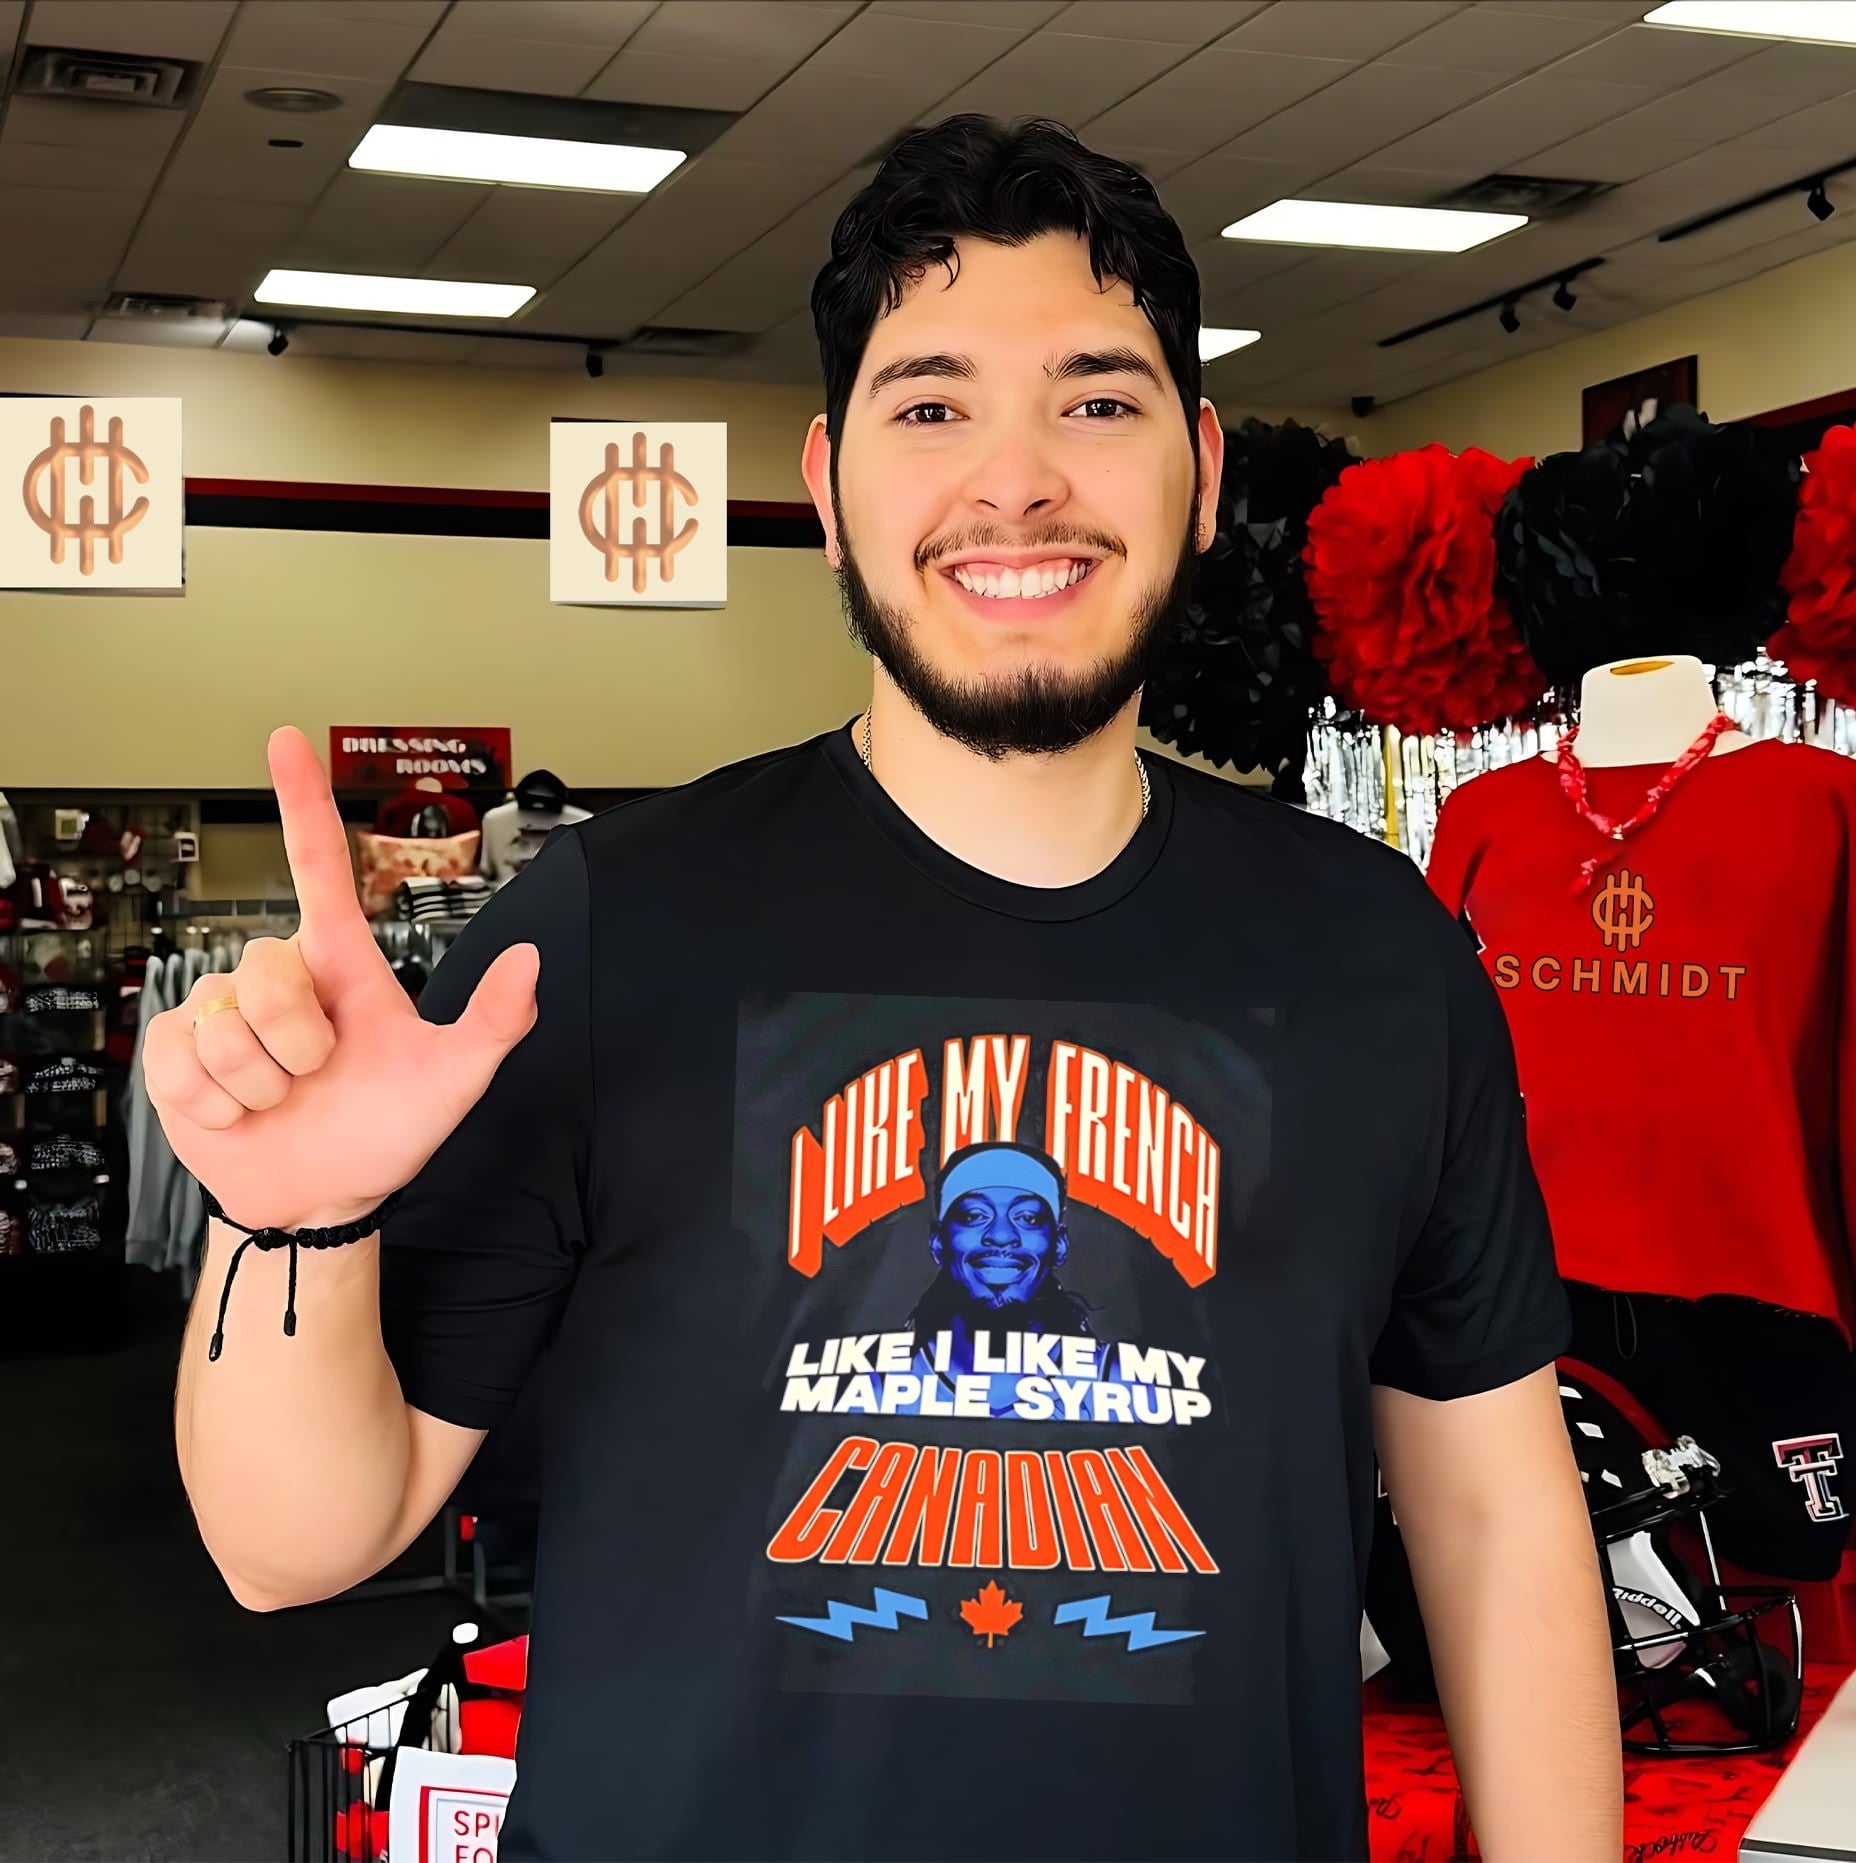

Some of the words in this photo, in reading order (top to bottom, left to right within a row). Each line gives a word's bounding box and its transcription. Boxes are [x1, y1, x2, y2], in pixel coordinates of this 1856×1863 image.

[342, 737, 467, 754] DRESSING
[396, 758, 487, 775] ROOMS
[1494, 952, 1747, 1000] SCHMIDT
[788, 1125, 823, 1278] I
[822, 1048, 929, 1248] LIKE
[939, 1034, 1031, 1172] MY
[1044, 1039, 1221, 1289] FRENCH
[785, 1331, 916, 1378] LIKE
[933, 1330, 953, 1373] I
[973, 1331, 1099, 1379] LIKE
[1117, 1342, 1207, 1391] MY
[779, 1373, 996, 1418] MAPLE
[1012, 1374, 1213, 1426] SYRUP
[765, 1435, 1221, 1575] CANADIAN
